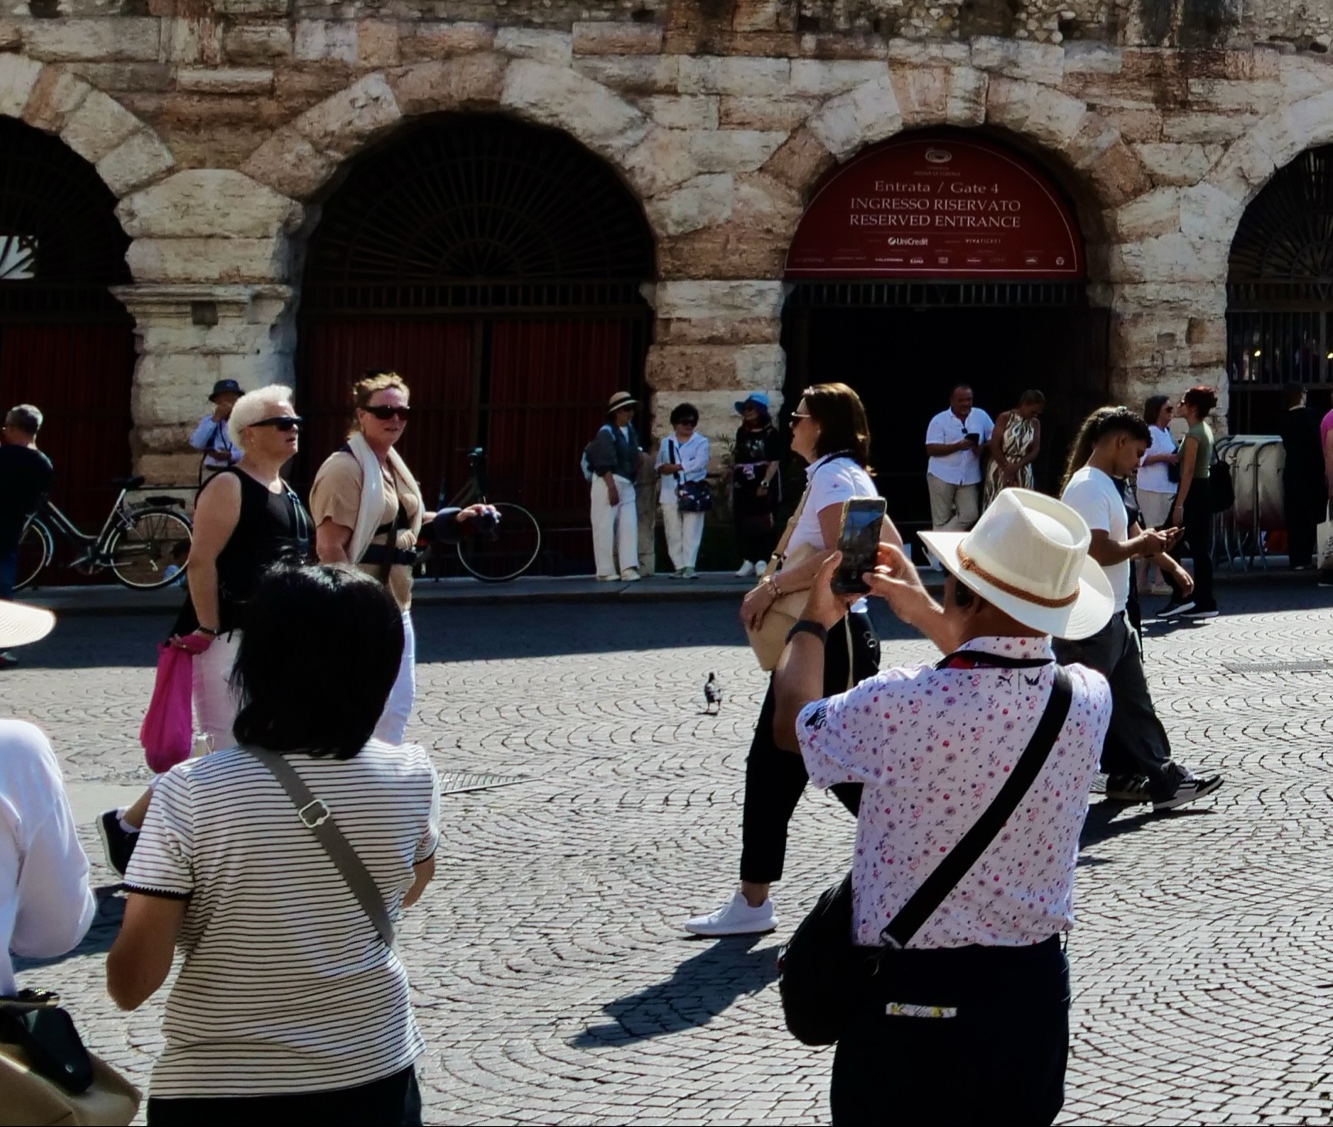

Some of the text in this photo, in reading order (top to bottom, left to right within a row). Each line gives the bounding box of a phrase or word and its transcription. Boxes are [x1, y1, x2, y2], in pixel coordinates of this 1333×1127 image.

[874, 180, 999, 194] Entrata / Gate 4
[850, 198, 1021, 212] INGRESSO RISERVATO
[849, 214, 1021, 228] RESERVED ENTRANCE
[897, 237, 929, 246] UniCredit
